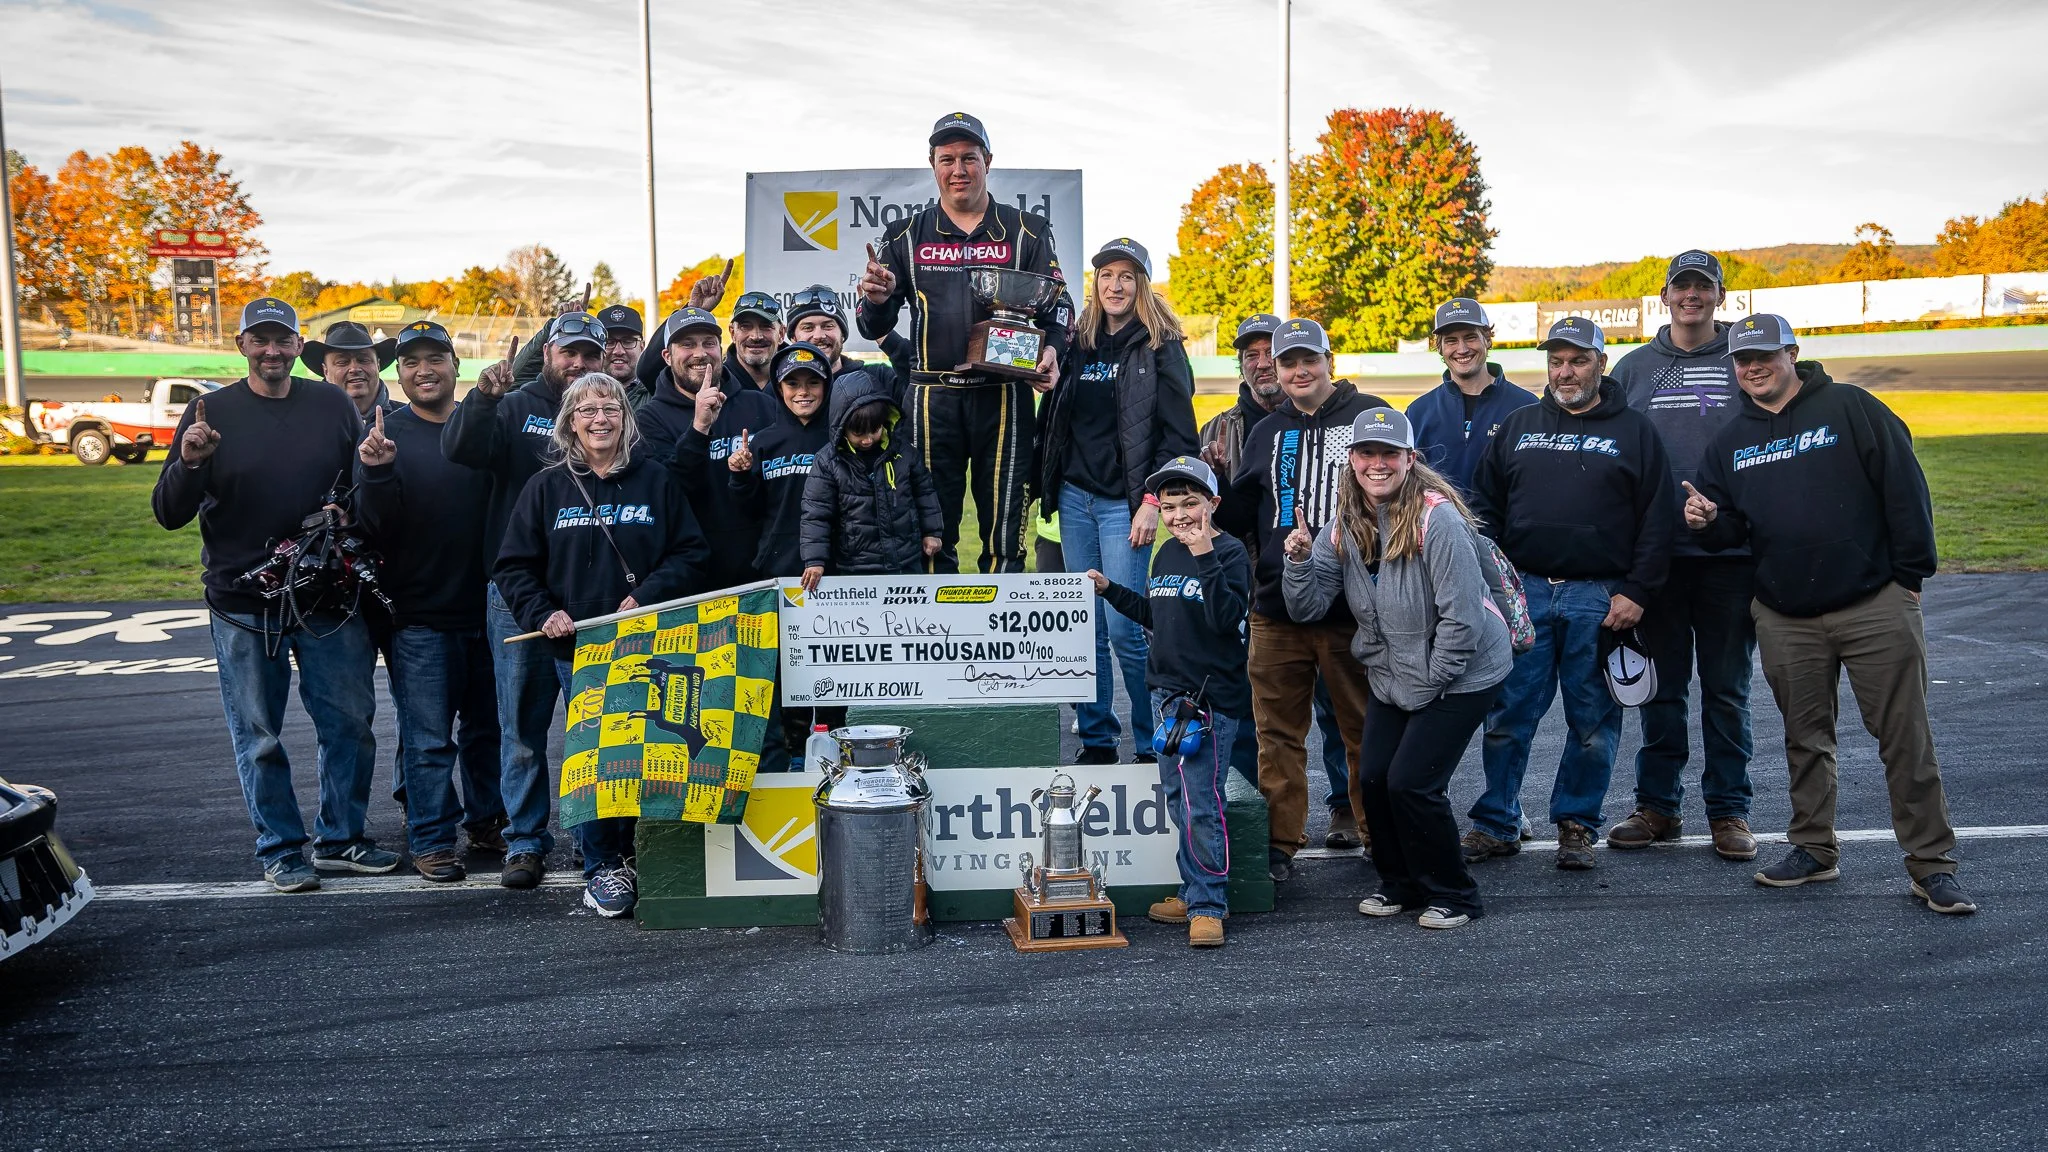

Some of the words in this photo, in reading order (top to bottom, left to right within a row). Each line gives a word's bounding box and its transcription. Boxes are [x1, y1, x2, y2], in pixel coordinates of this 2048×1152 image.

[849, 194, 1053, 228] Norld
[920, 245, 1007, 261] CHAMPEAU
[1737, 329, 1764, 338] Northfield
[522, 414, 555, 432] PEL
[527, 425, 554, 436] RAC
[1282, 429, 1300, 454] BUILT
[1518, 441, 1576, 451] RACING
[1582, 436, 1614, 452] 64
[1798, 427, 1826, 450] 64
[1734, 434, 1799, 471] PELKEY
[1737, 449, 1792, 470] RACING
[762, 454, 814, 480] PELKE
[1281, 454, 1296, 487] Ford
[621, 505, 648, 522] 64
[1281, 487, 1294, 527] TOUGH
[886, 586, 928, 595] MILK
[1044, 578, 1082, 586] 88022
[1150, 574, 1187, 596] ELKEY
[1150, 587, 1178, 598] CING
[808, 587, 877, 600] Northfield
[882, 596, 931, 605] BOWL
[1009, 591, 1034, 600] Oct.
[1038, 591, 1049, 600] 2,
[1053, 591, 1083, 599] 2022
[812, 614, 870, 635] Chris
[879, 610, 951, 644] Pelkey
[989, 610, 1088, 638] $12,000.00
[808, 643, 893, 663] TWELVE
[901, 641, 1015, 662] THOUSAND
[1019, 641, 1053, 660] 00/100
[673, 677, 684, 704] THUNDER
[813, 677, 834, 698] 60th
[835, 682, 875, 698] MILK
[878, 681, 924, 697] BOWL
[672, 706, 682, 721] ROAD
[931, 784, 1170, 841] rtheld
[932, 851, 1034, 872] VINGS
[1093, 850, 1133, 866] NK
